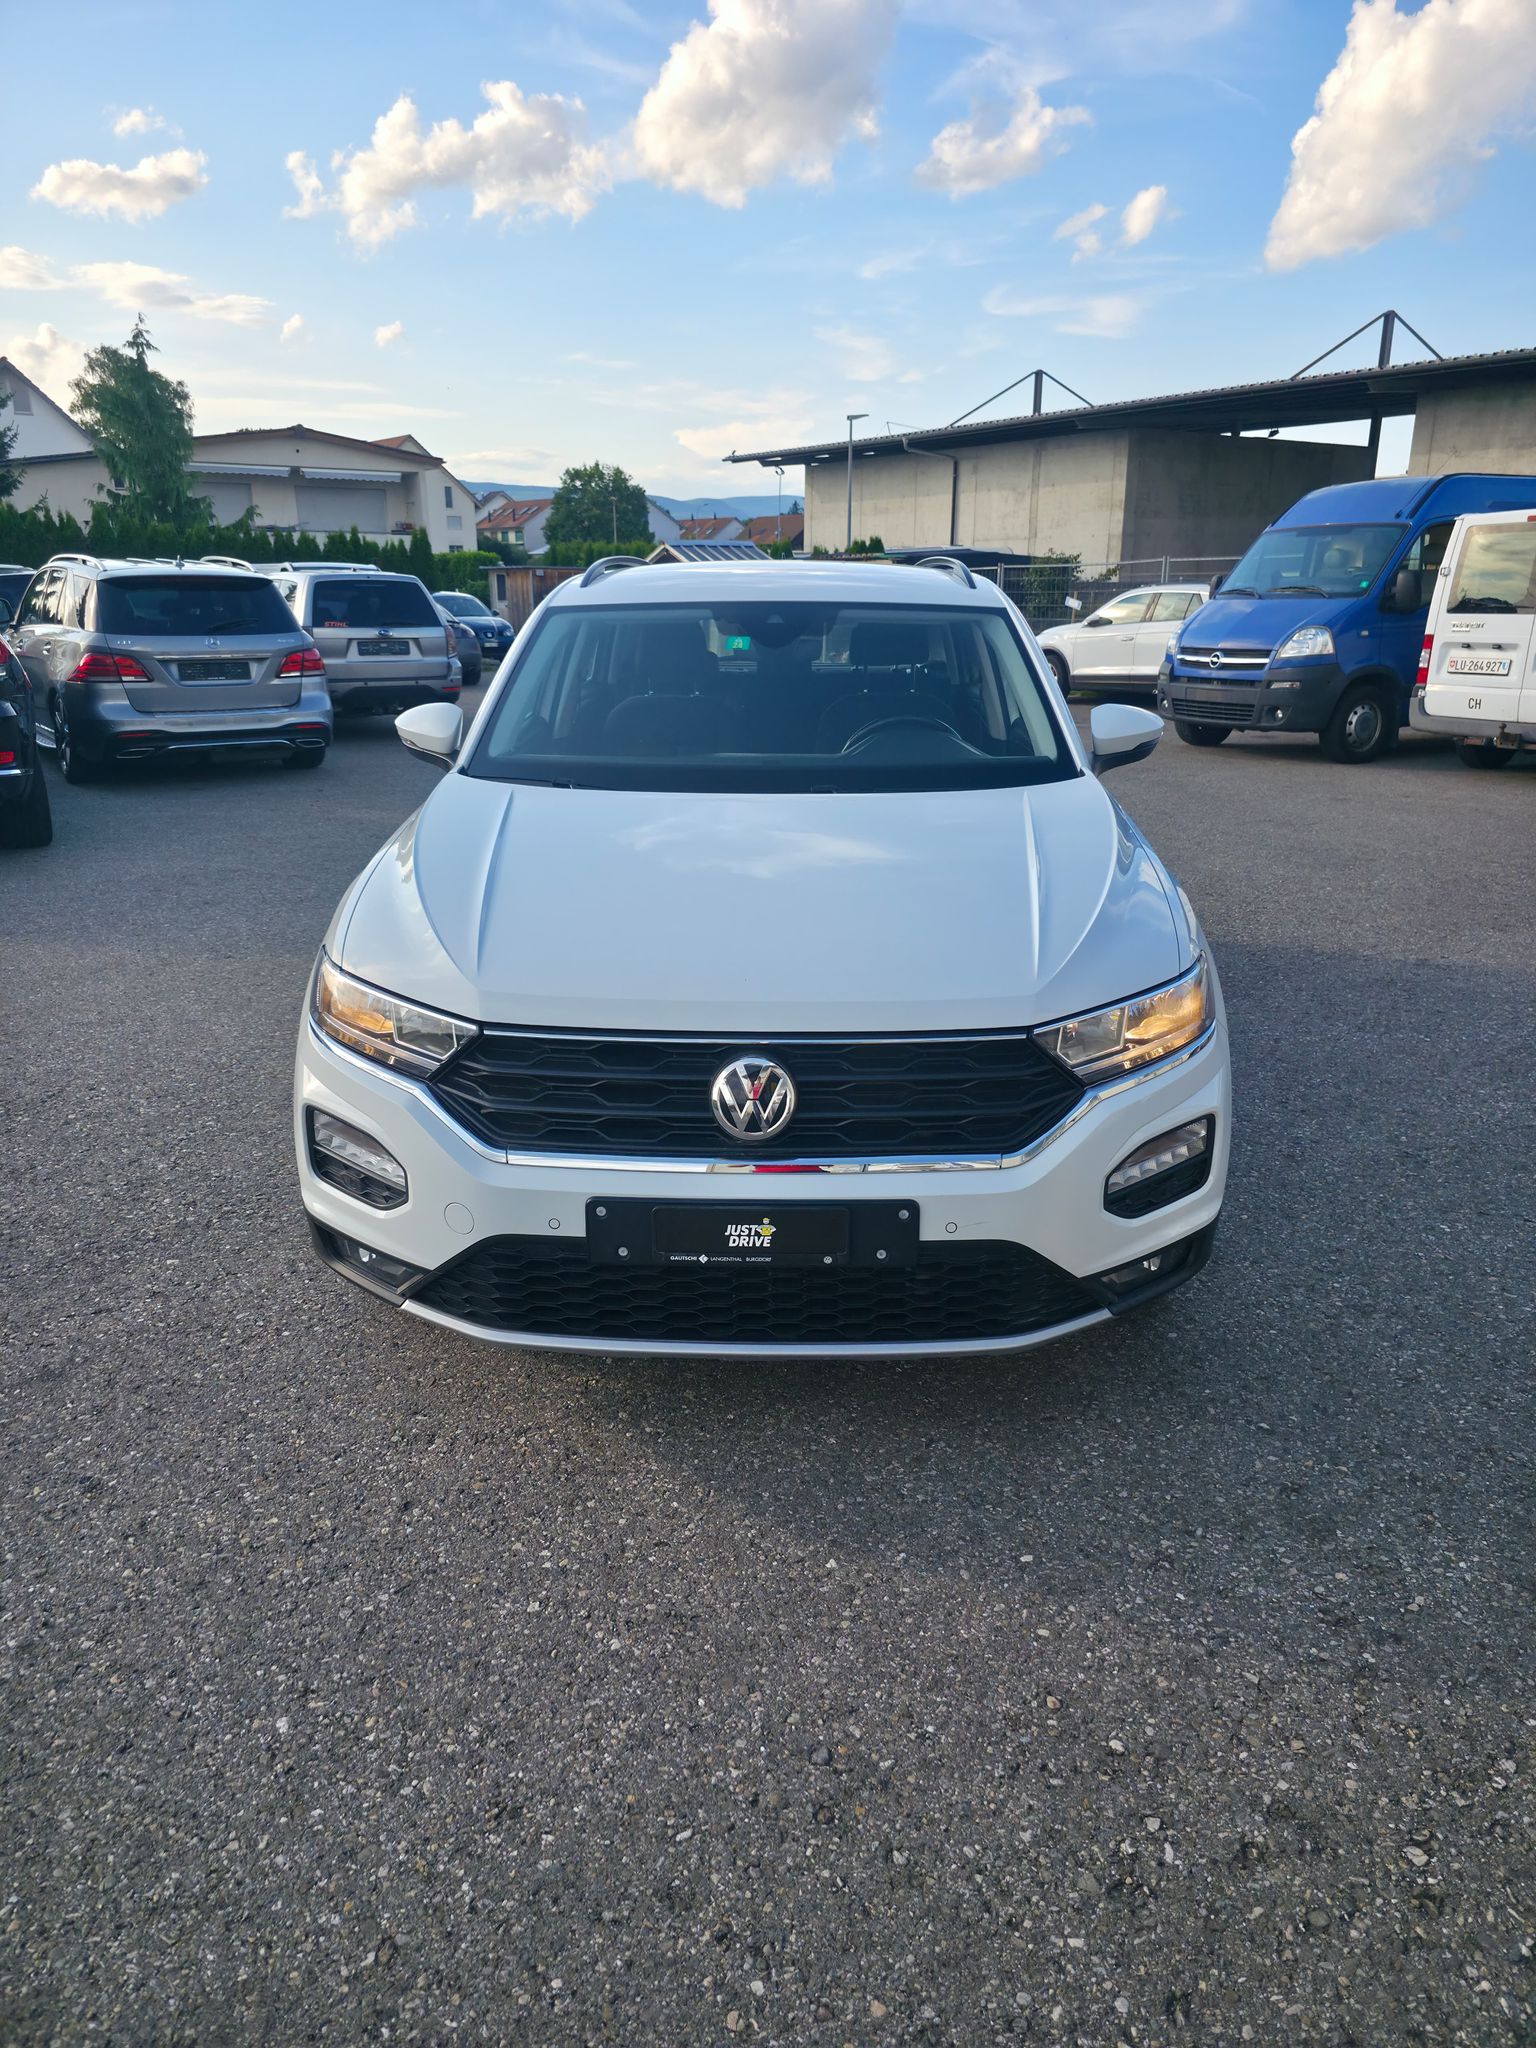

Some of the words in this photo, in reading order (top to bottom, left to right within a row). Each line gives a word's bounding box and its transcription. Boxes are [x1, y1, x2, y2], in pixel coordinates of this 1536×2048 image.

[1468, 697, 1482, 710] CH
[724, 1224, 758, 1236] JUST
[728, 1236, 772, 1247] DRIVE
